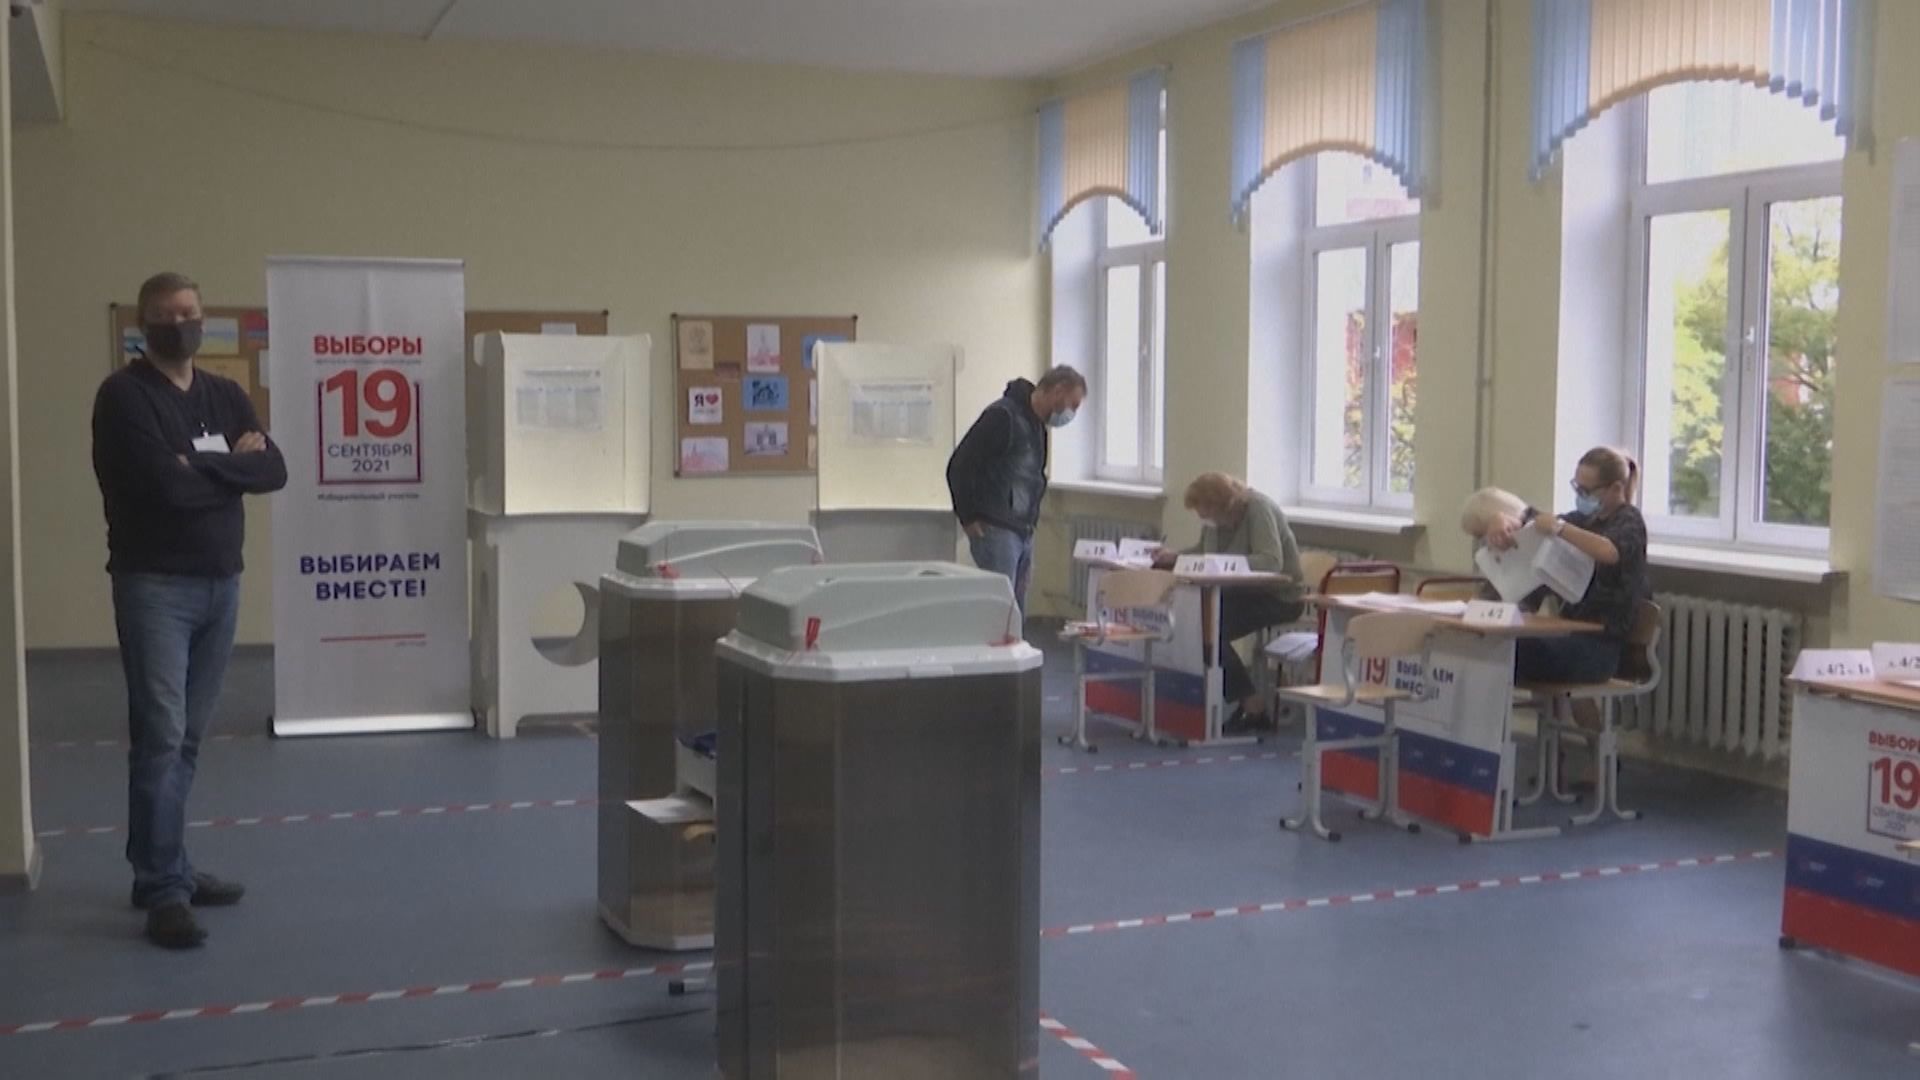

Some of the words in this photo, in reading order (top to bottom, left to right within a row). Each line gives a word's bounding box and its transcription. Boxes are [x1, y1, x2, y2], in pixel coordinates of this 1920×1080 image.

[314, 335, 422, 355] ВЫБОРЫ
[326, 368, 411, 438] 19
[327, 443, 413, 458] СЕНТЯБРЯ
[352, 459, 390, 473] 2021
[300, 552, 441, 575] ВЫБИРАЕМ
[1223, 561, 1237, 572] 14
[316, 578, 426, 600] ВМЕСТЕ!
[1869, 730, 1920, 752] ВЫБОР
[1874, 756, 1920, 811] 19
